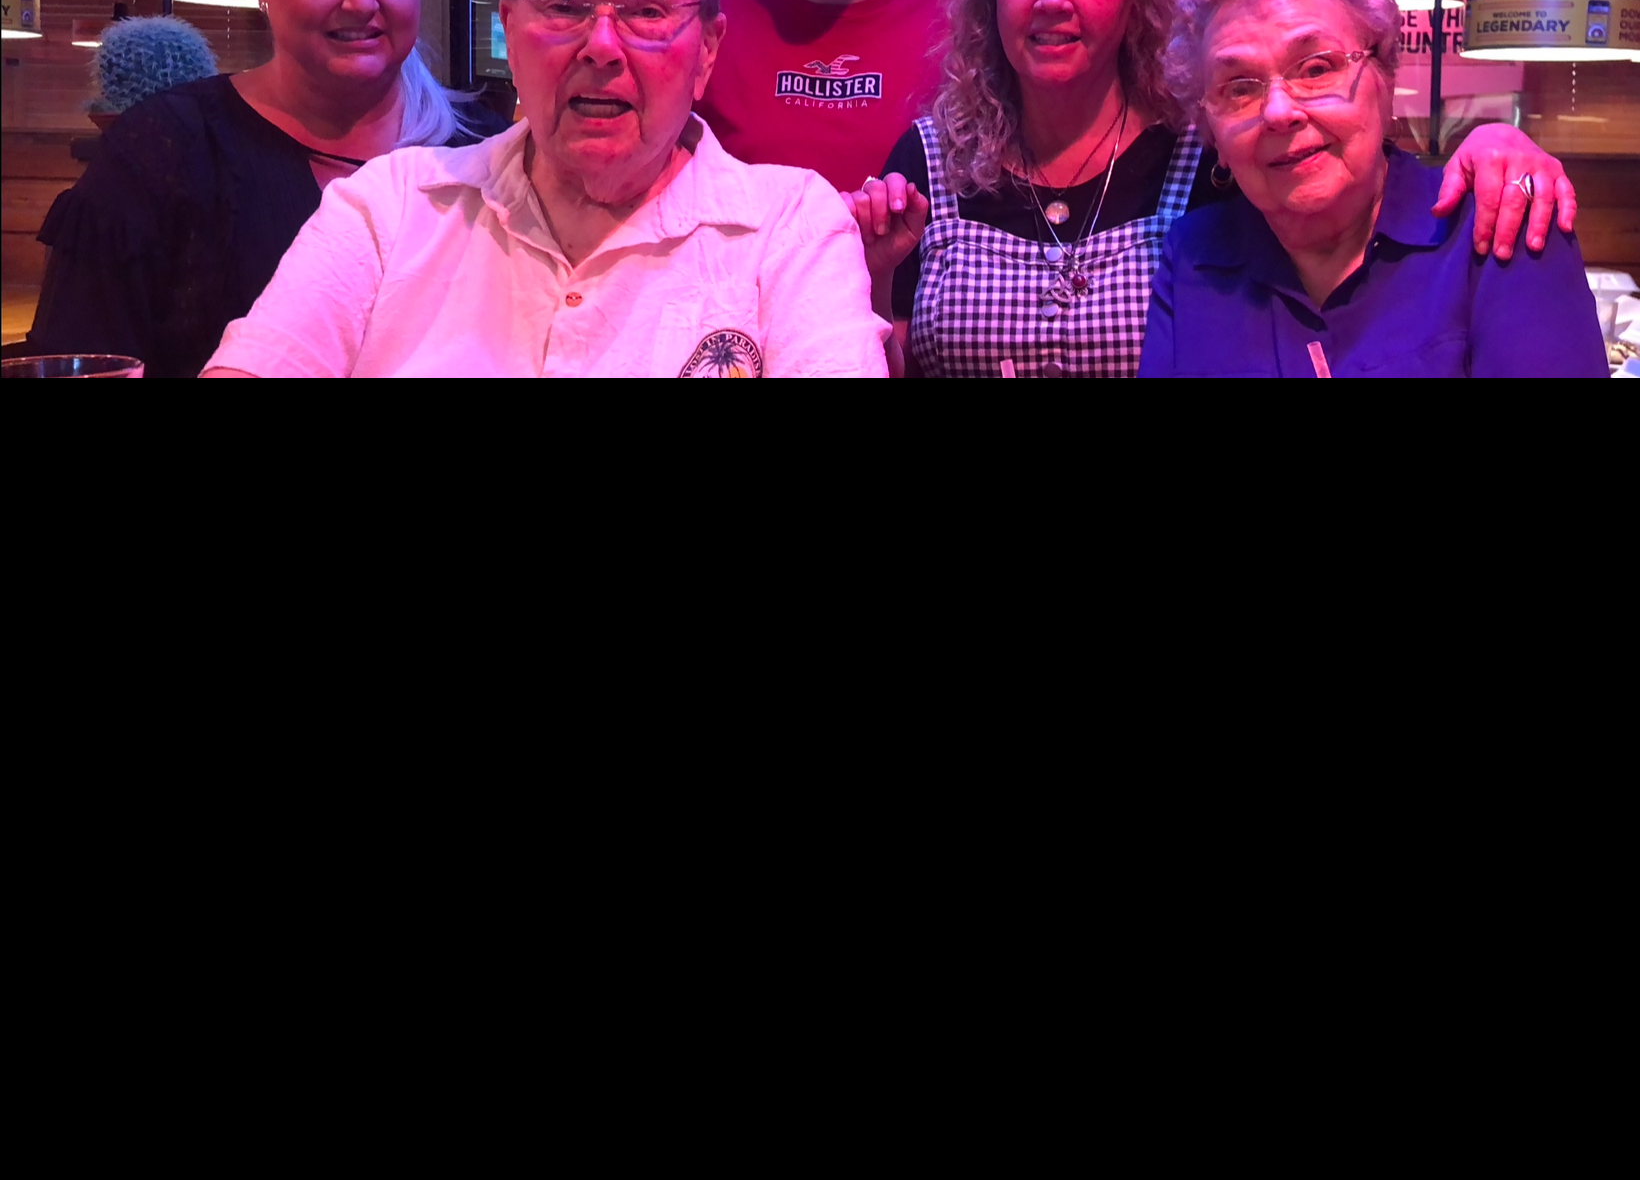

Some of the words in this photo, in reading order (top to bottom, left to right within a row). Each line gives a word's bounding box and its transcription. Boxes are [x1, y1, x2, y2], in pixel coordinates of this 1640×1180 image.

[1535, 10, 1547, 18] TO
[1476, 19, 1570, 33] LEGENDARY
[781, 74, 876, 97] HOLLISTER
[785, 97, 868, 110] CALIFORNIA
